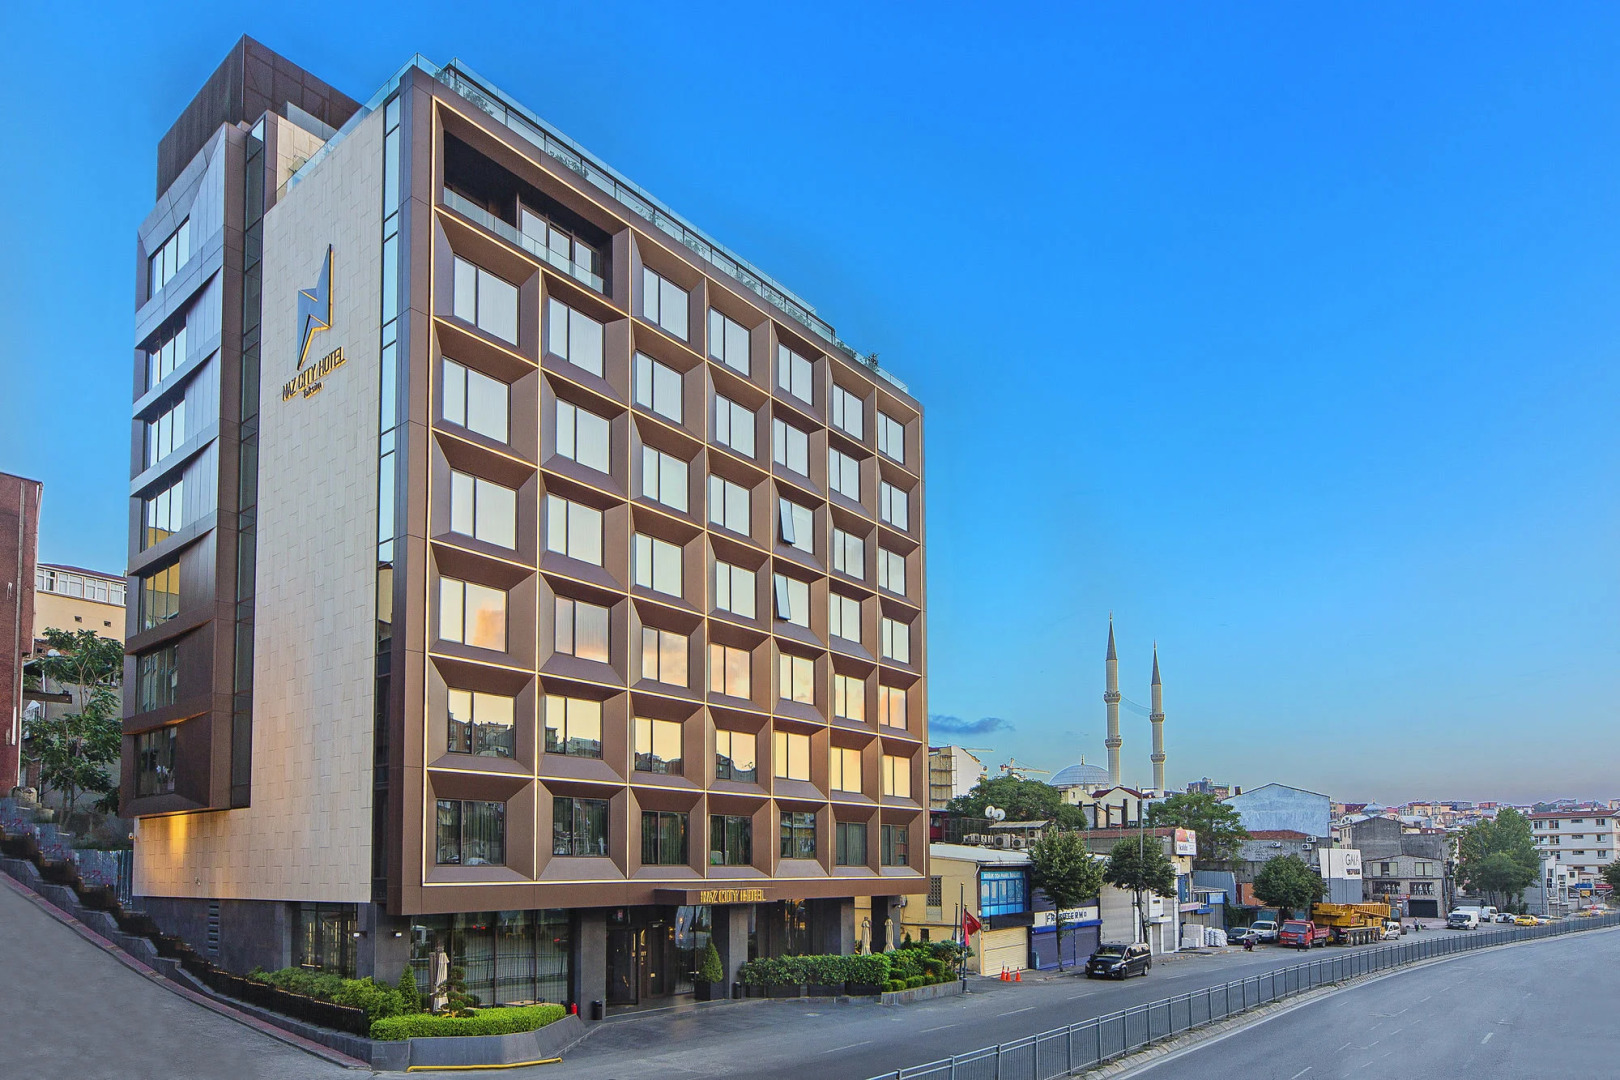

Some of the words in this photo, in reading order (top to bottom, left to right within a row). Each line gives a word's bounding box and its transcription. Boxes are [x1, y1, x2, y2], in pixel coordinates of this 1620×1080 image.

[282, 376, 297, 402] NAZ
[298, 363, 318, 391] CITY
[319, 346, 347, 377] HOTEL
[700, 890, 718, 904] NAZ
[719, 889, 739, 903] CITY
[740, 889, 767, 902] HOTEL
